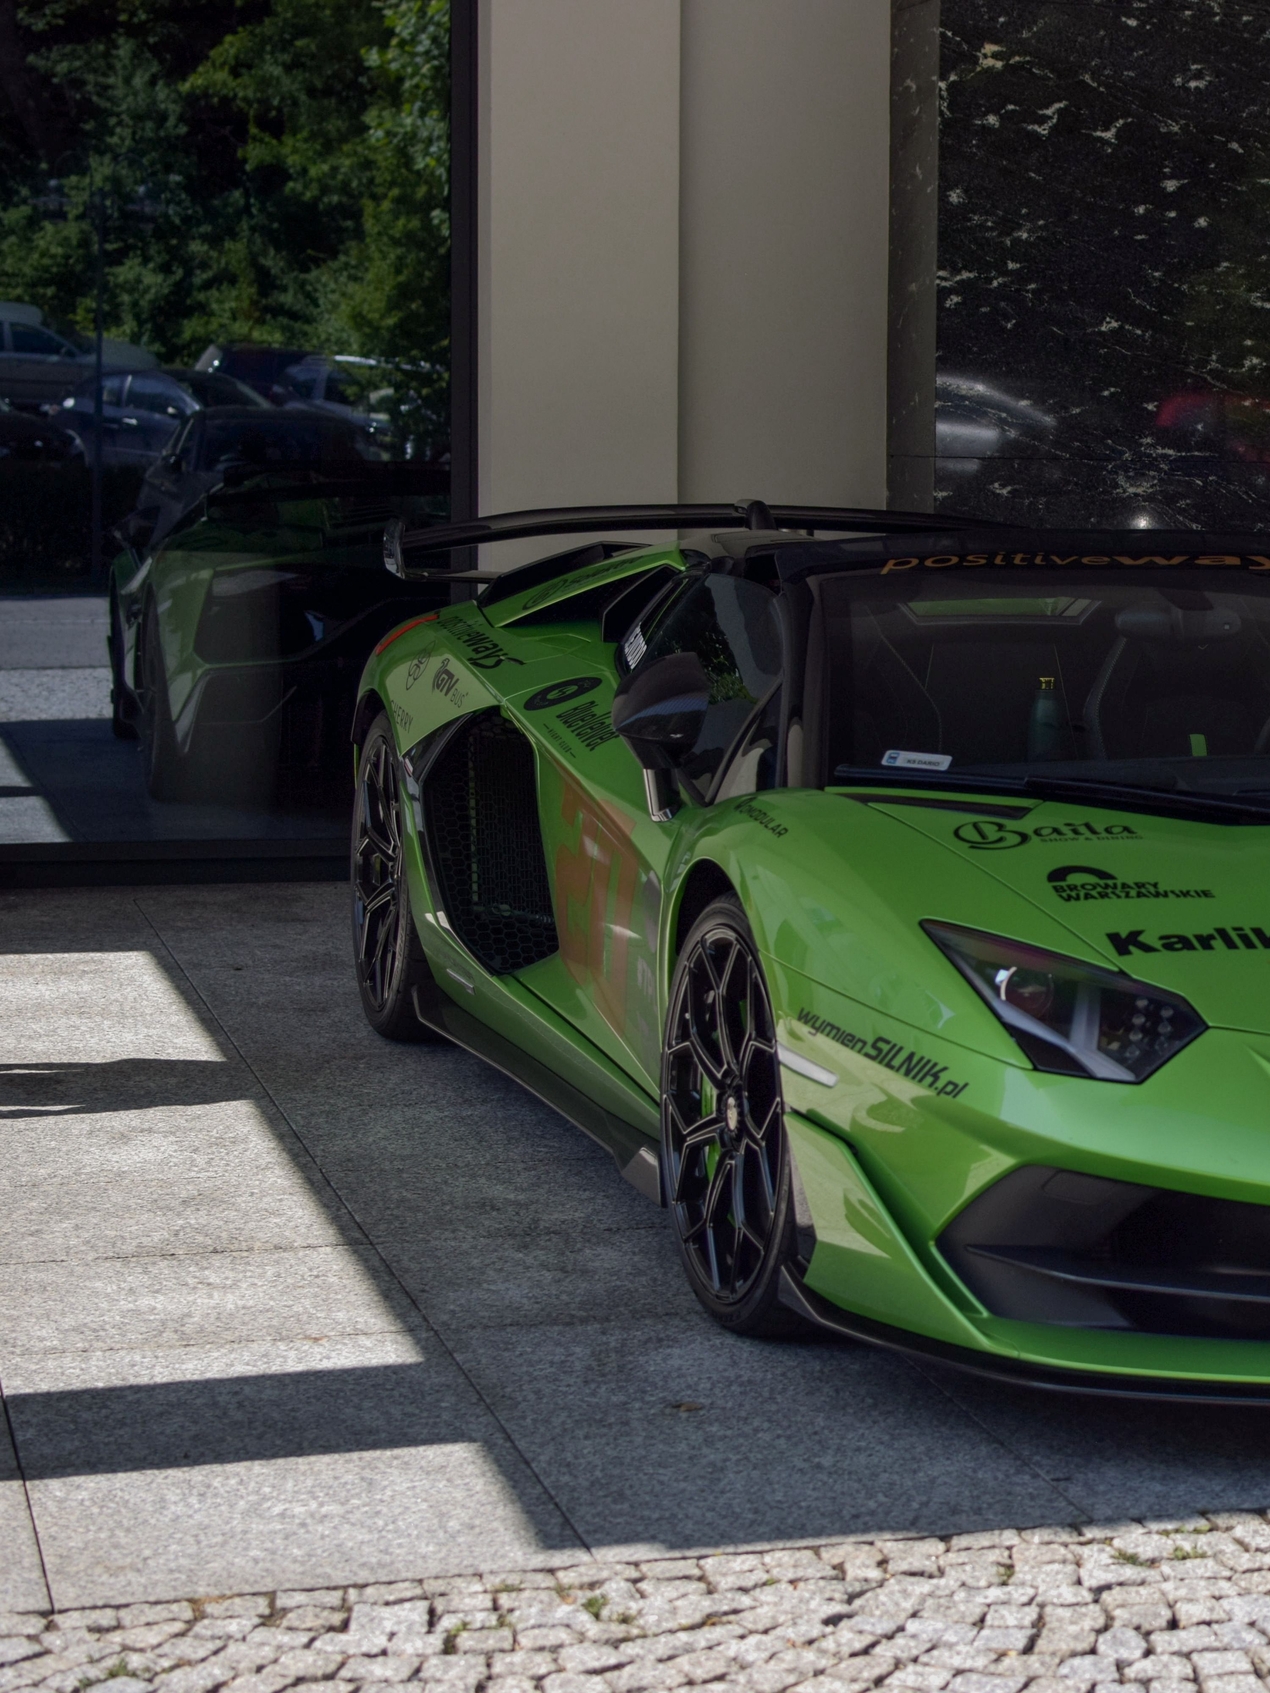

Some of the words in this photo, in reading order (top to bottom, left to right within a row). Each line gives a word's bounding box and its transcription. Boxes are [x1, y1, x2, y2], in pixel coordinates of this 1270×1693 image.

[953, 820, 1137, 850] Baila
[1052, 881, 1160, 894] BROWARY
[1056, 889, 1216, 902] WARSZAWSKIE
